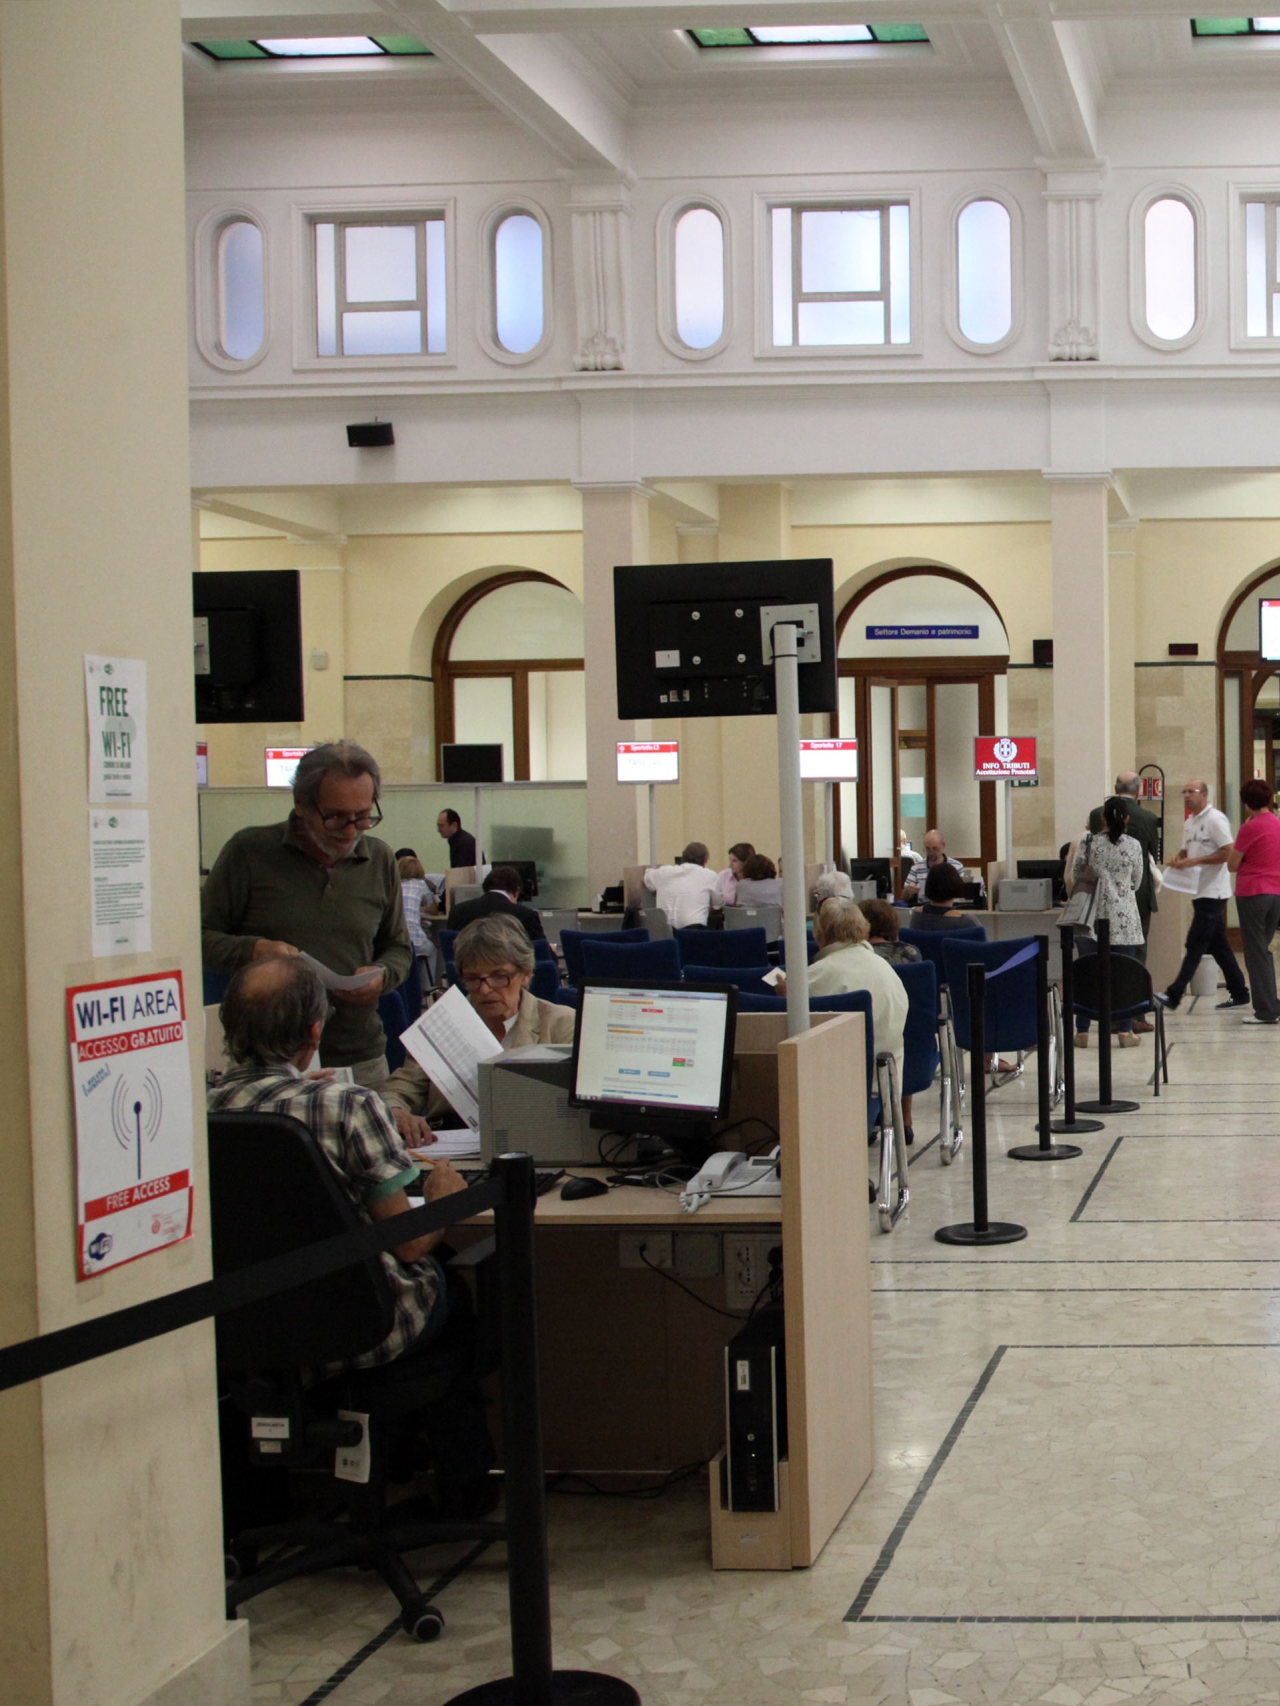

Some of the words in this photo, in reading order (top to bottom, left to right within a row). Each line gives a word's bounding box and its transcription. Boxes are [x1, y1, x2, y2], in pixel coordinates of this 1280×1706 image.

[938, 628, 972, 636] patrimonio
[99, 686, 129, 717] FREE
[102, 731, 131, 758] WI-FI
[76, 995, 126, 1029] WI-FI
[132, 988, 178, 1020] AREA
[79, 1036, 128, 1059] ACCESSO
[130, 1025, 182, 1048] GRATUITO
[106, 1190, 130, 1211] FREE
[132, 1176, 170, 1202] ACCESS
